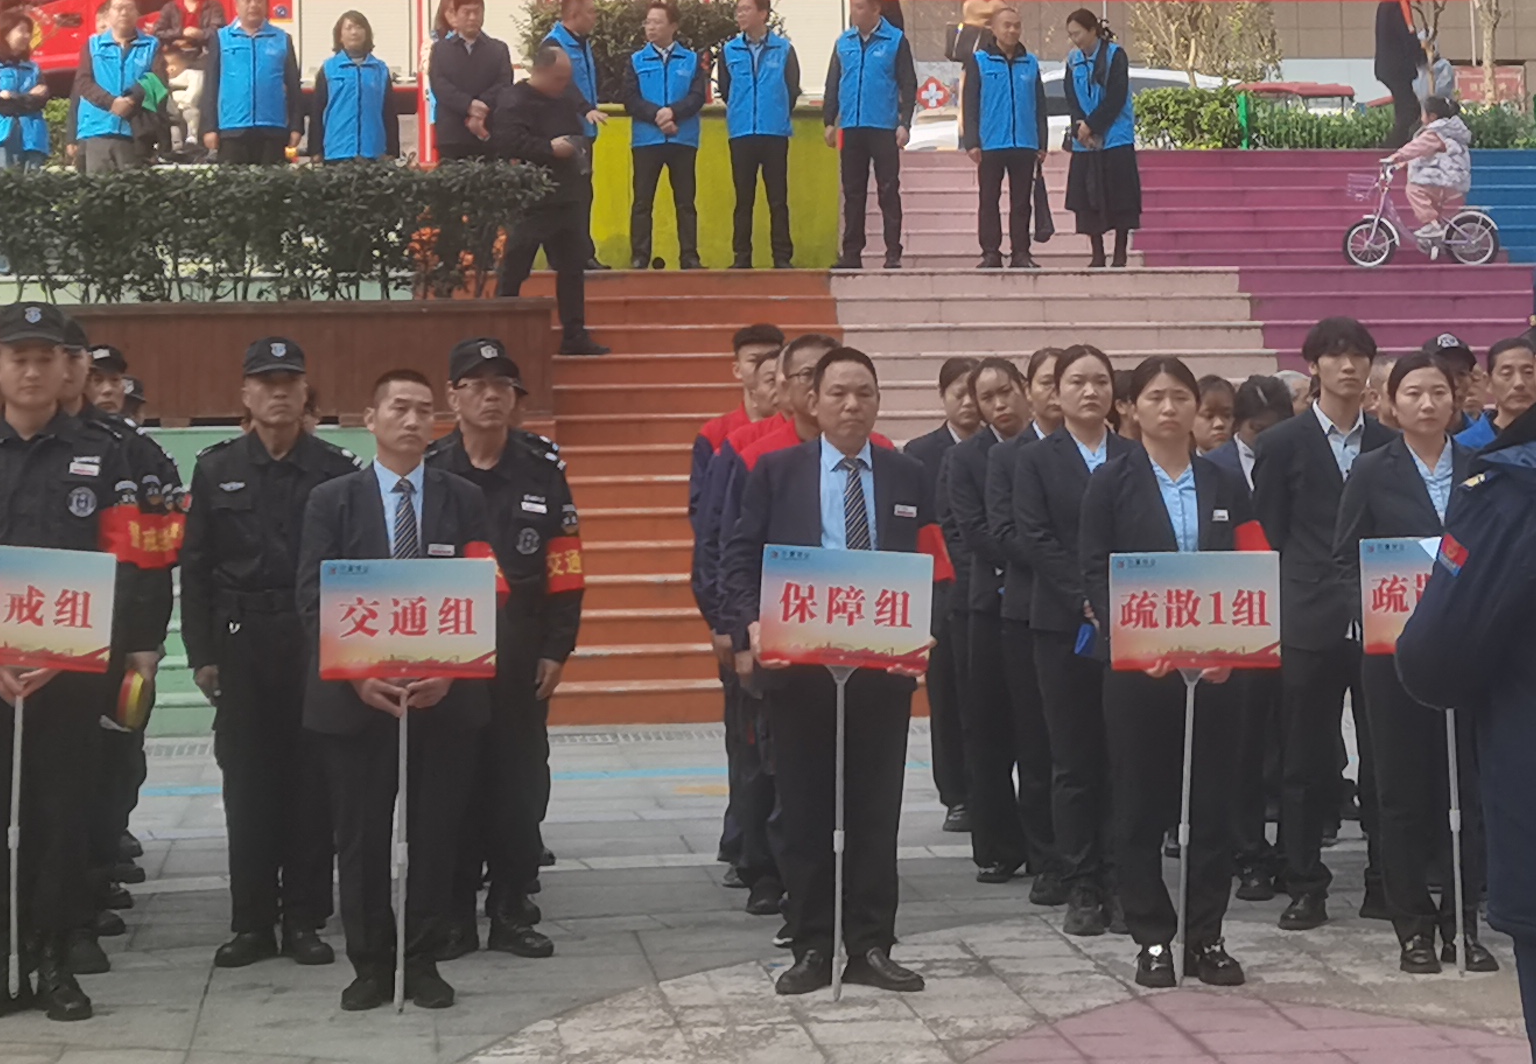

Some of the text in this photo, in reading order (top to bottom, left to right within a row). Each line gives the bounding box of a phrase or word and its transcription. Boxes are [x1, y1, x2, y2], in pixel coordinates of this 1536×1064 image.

[338, 597, 478, 639] 交通组
[779, 582, 913, 628] 保障组
[1119, 588, 1272, 628] 疏散1组
